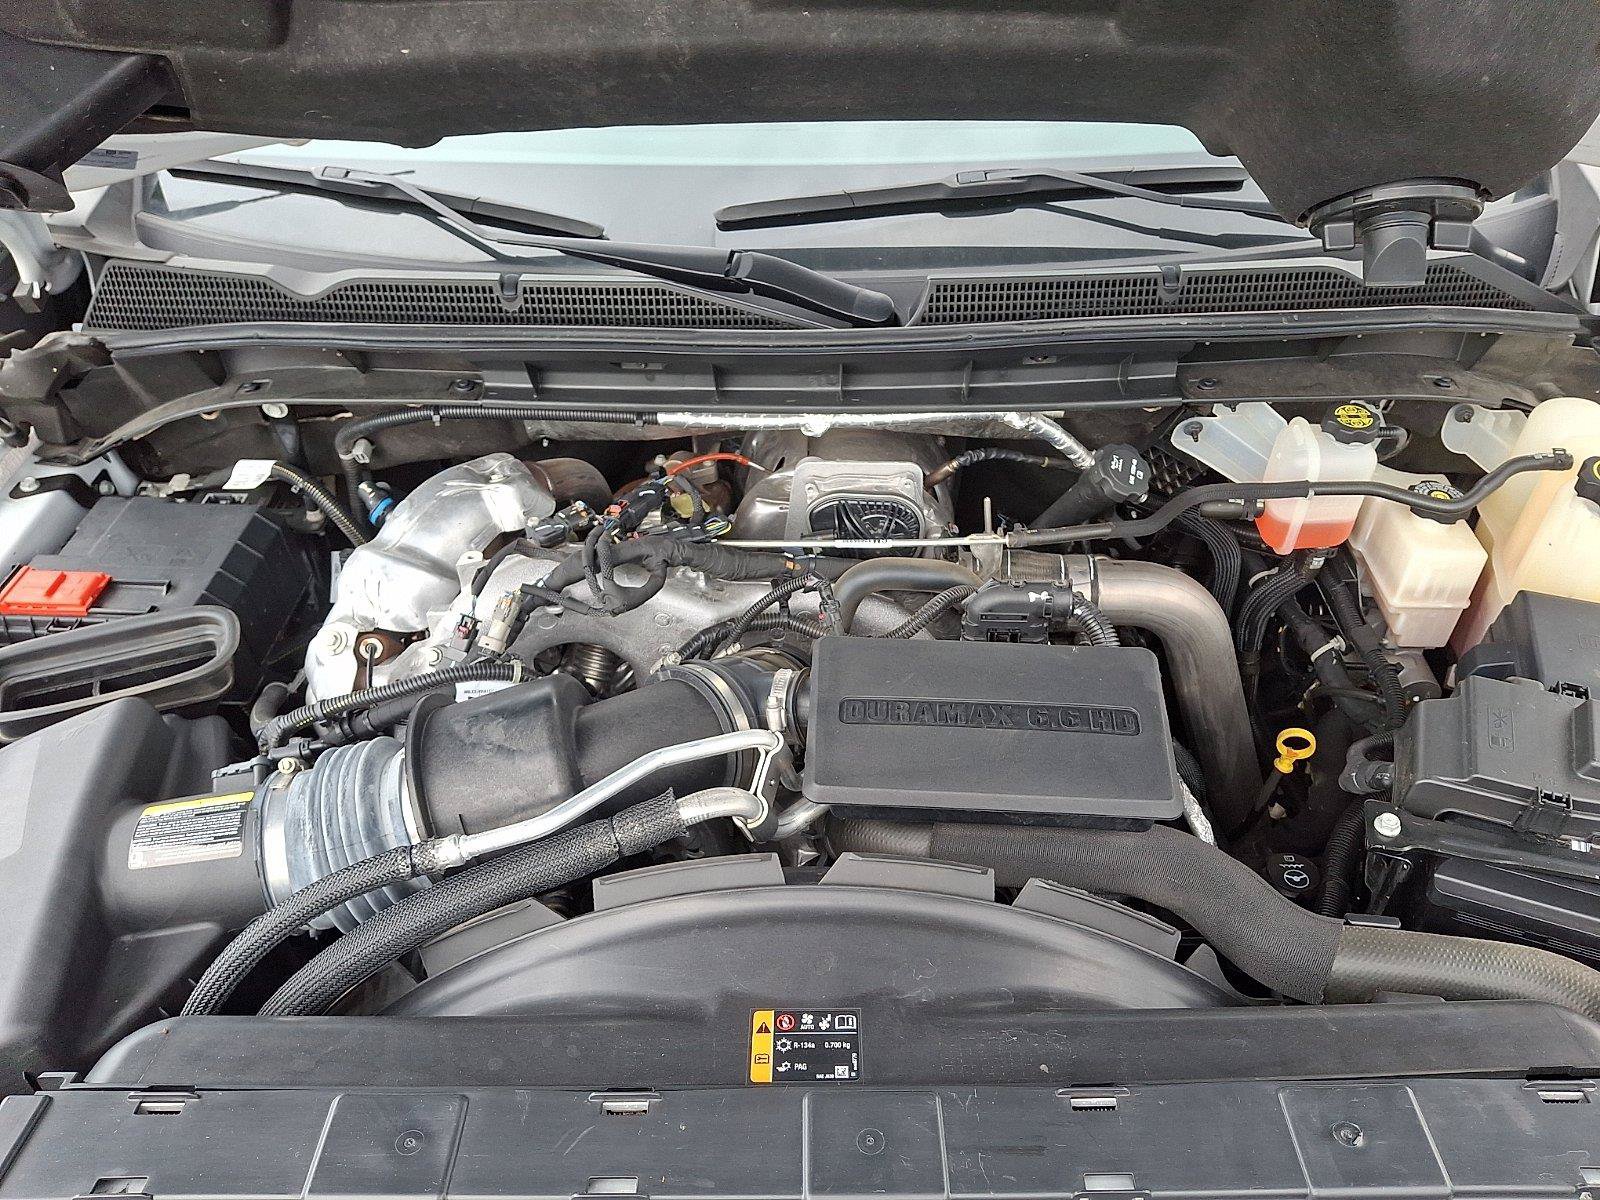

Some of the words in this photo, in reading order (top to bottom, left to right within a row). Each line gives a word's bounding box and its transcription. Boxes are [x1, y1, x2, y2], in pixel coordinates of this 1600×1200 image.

[843, 701, 1014, 726] DURAMAX
[1027, 706, 1080, 729] 6.6
[1088, 709, 1137, 733] HD
[842, 1042, 851, 1050] kg
